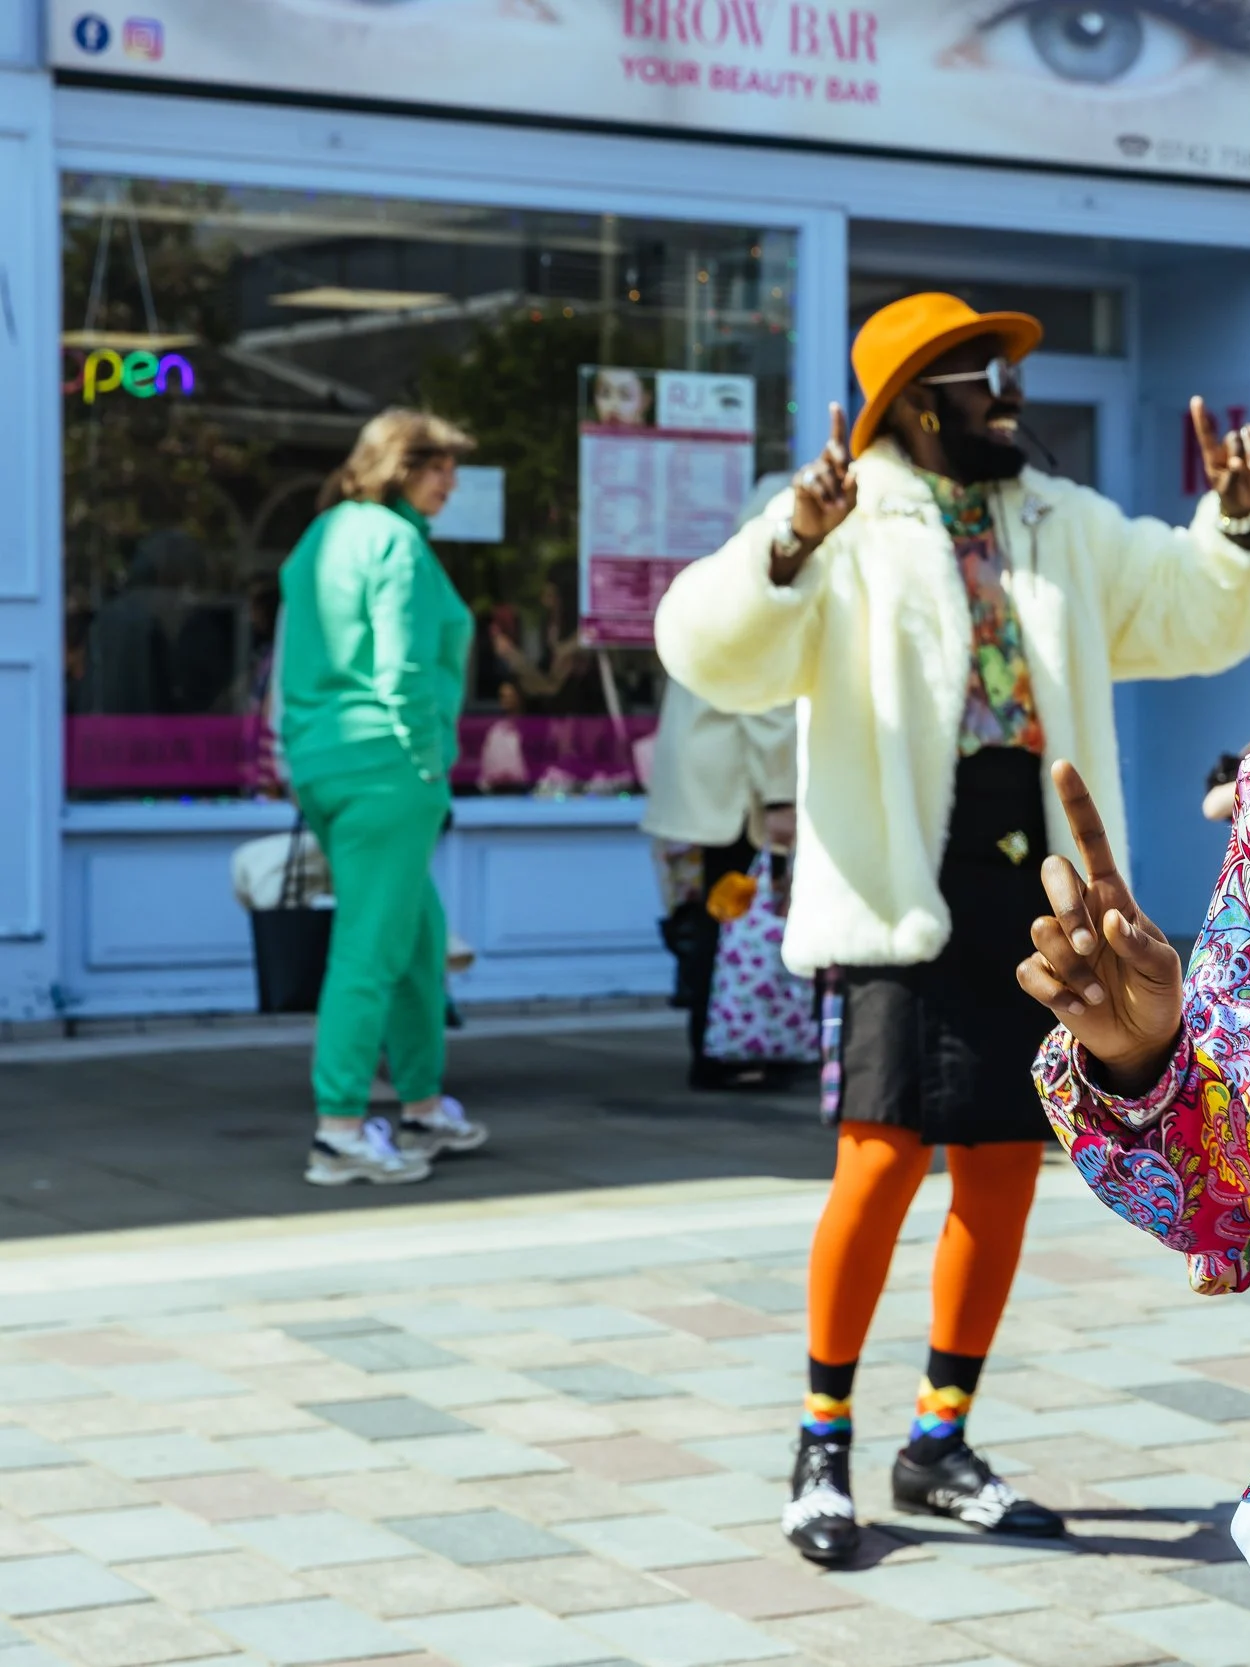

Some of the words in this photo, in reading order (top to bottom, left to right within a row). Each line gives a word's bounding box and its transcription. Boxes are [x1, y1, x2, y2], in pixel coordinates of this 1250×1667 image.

[623, 0, 775, 46] BROW
[789, 3, 880, 62] BAR
[620, 55, 700, 86] YOUR
[708, 63, 815, 98] BEAUTY
[825, 76, 880, 104] BAR
